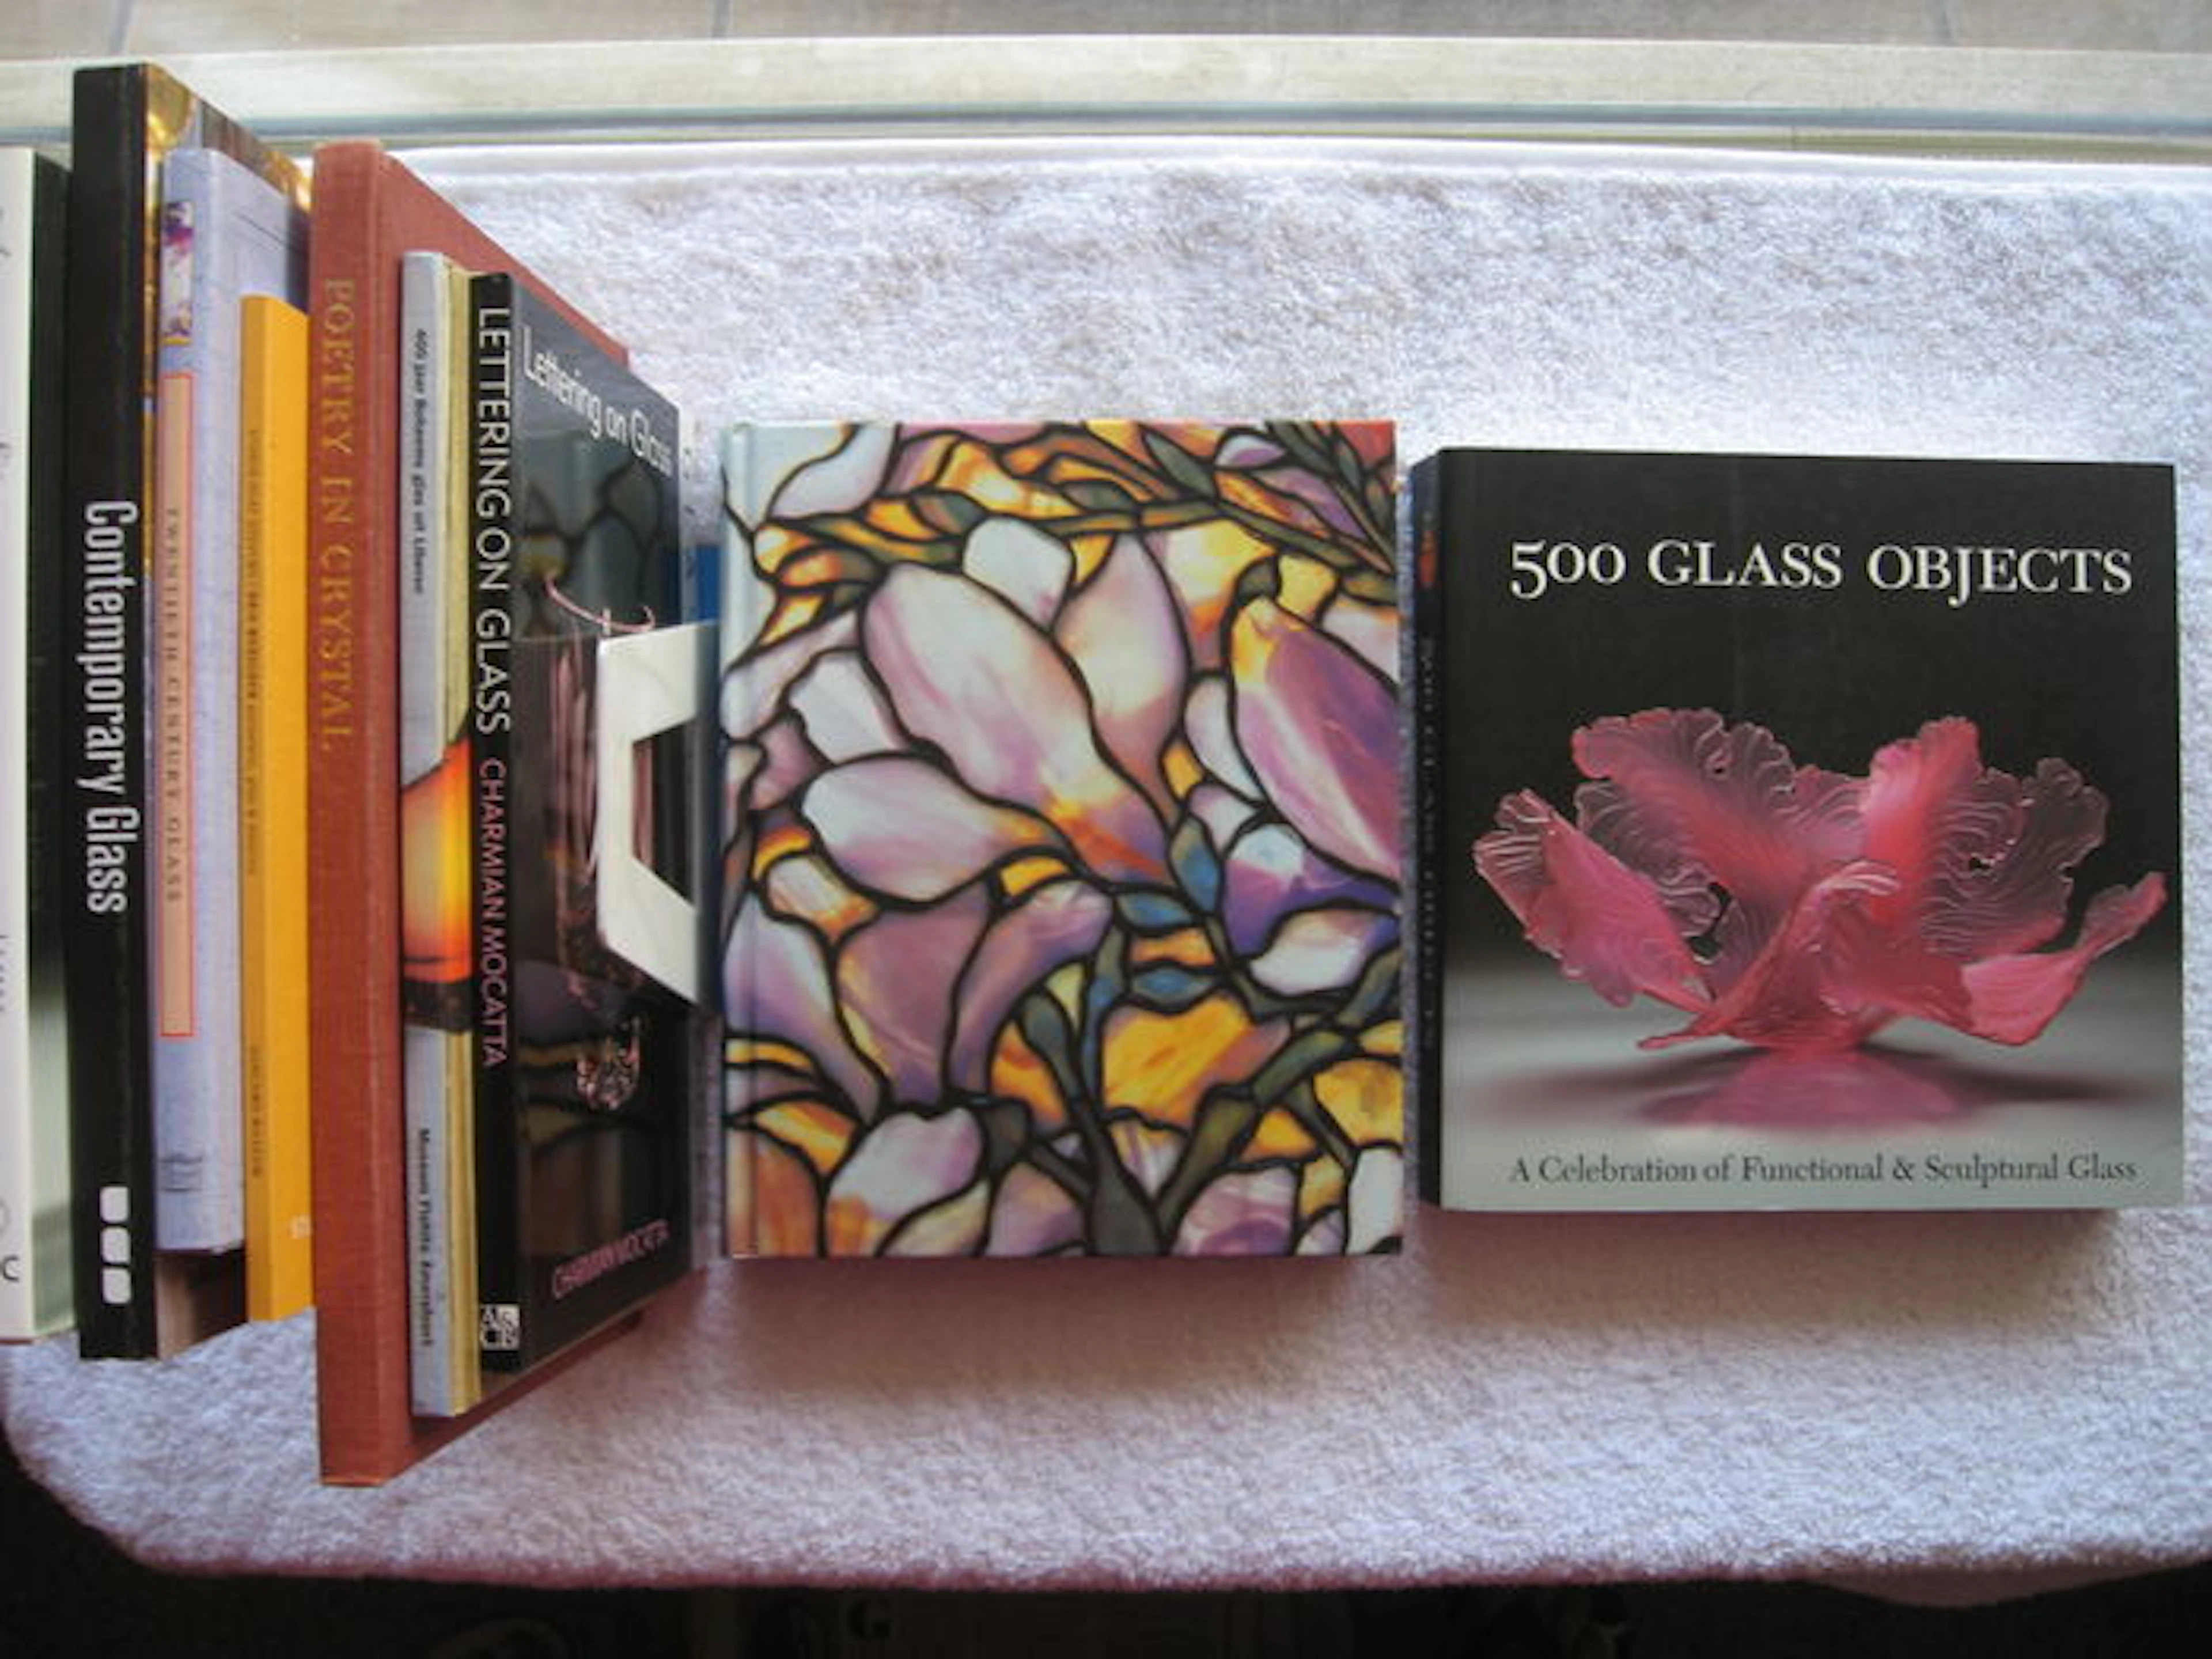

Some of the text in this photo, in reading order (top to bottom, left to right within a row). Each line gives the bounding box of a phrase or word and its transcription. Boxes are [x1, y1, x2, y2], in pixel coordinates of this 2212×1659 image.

[321, 278, 355, 454] POETRY
[524, 326, 601, 440] Lettering
[607, 405, 627, 446] on
[321, 476, 354, 523] IN
[1512, 539, 2132, 607] 500 GLASS OBJECTS
[76, 501, 142, 913] Contemporary Glass
[476, 309, 510, 1066] LETTERING ON GLASS CHARMIAN MOCATTA
[1508, 1153, 2138, 1189] A Celebration of Functional & Sculptural Glass
